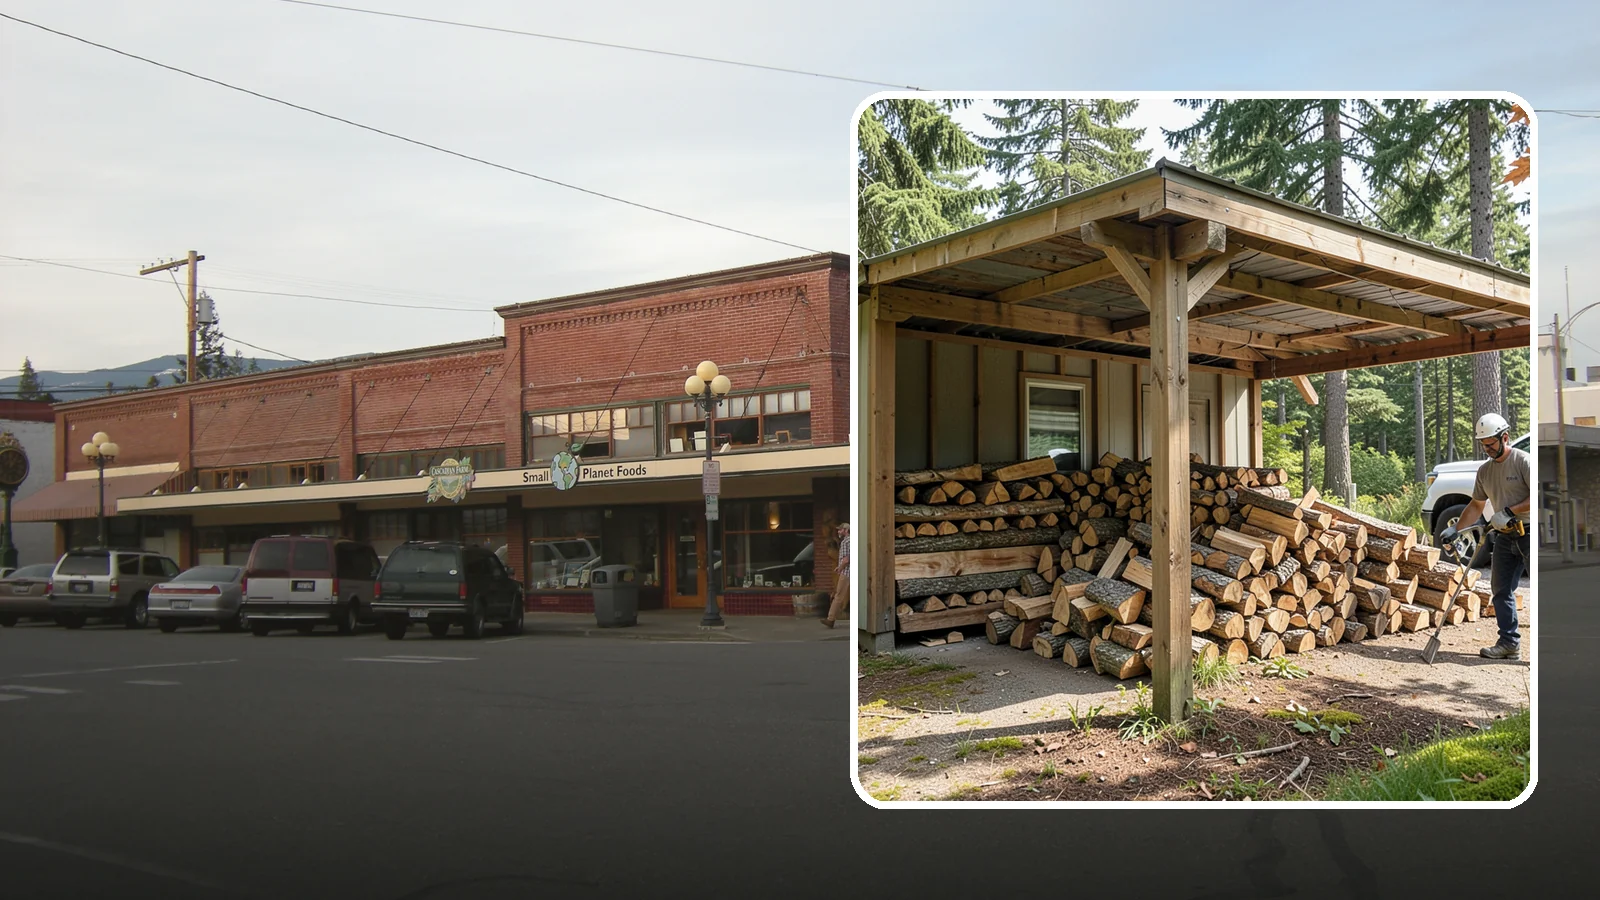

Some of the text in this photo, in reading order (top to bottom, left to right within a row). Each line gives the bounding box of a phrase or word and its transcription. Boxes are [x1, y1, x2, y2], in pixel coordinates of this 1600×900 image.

[523, 464, 647, 482] Small Planet Foods
